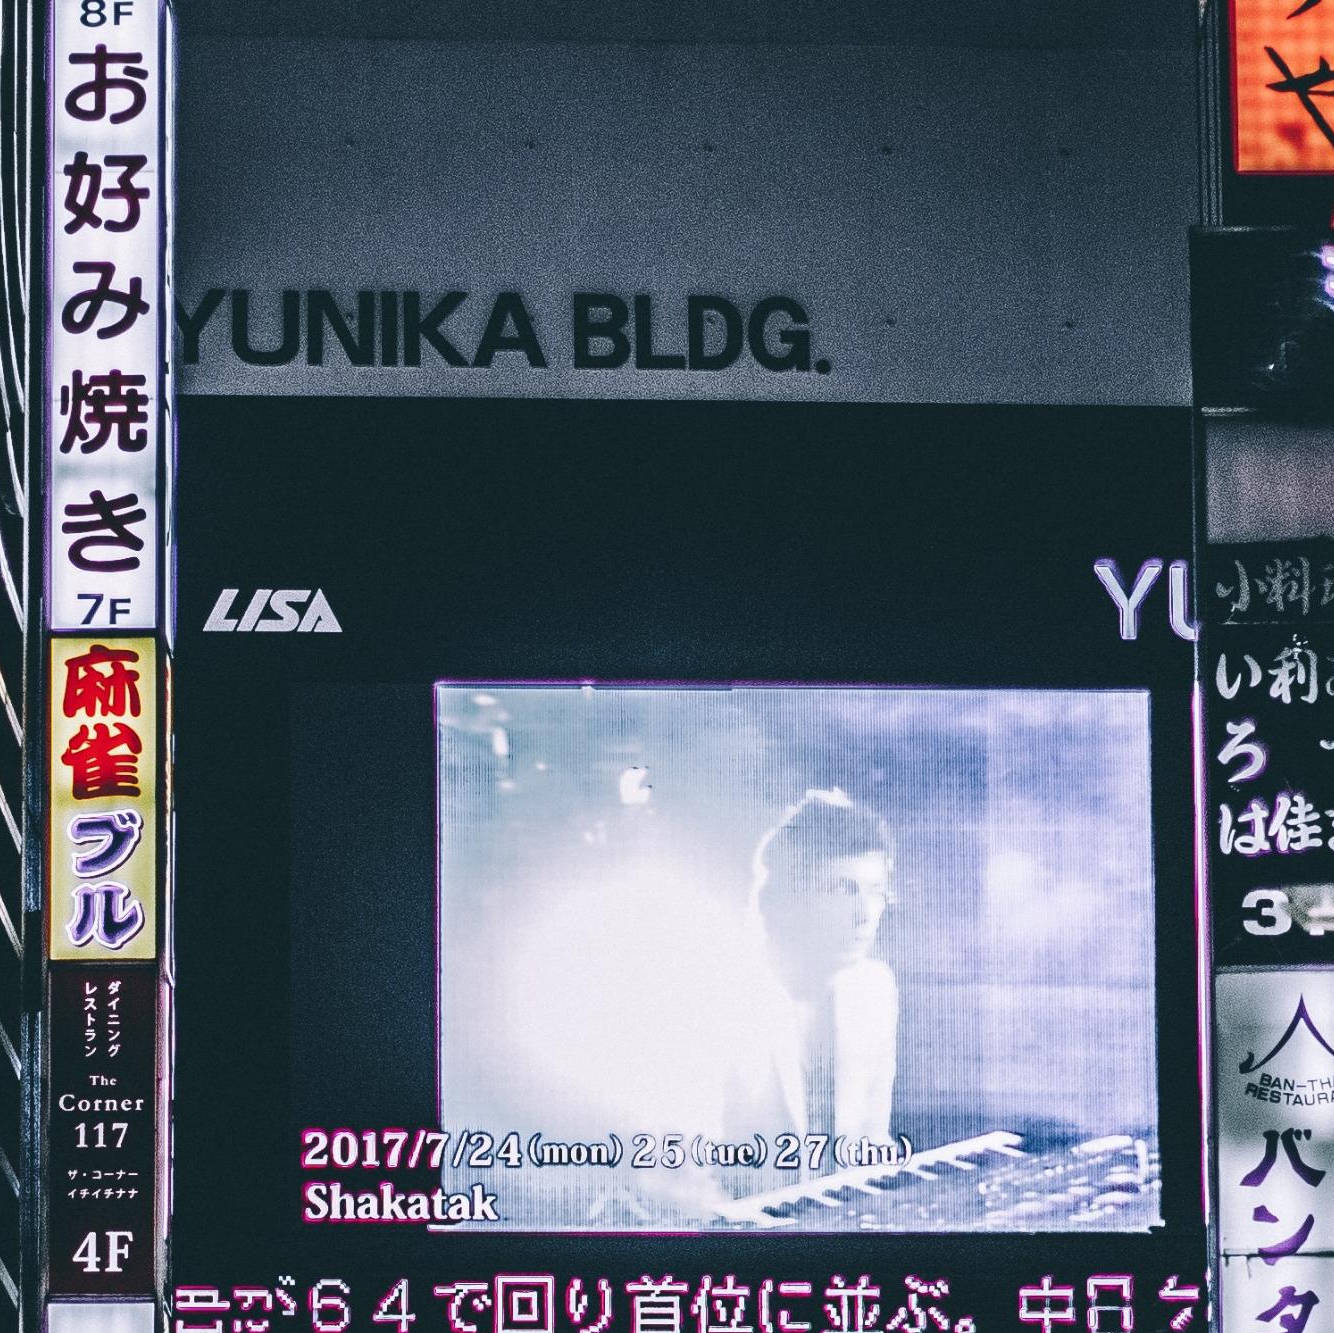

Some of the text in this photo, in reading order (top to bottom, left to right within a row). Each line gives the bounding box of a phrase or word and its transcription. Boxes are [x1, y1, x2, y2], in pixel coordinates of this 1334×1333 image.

[79, 1, 135, 28] 8F
[59, 43, 151, 574] お好み焼き
[173, 288, 832, 376] YUNIKA BLDG.
[76, 593, 133, 626] 7F
[201, 587, 343, 633] LISA
[84, 981, 98, 1058] レストラン
[107, 980, 121, 1058] ダイニング
[89, 1075, 117, 1086] The
[58, 1094, 144, 1113] Corner
[73, 1122, 129, 1149] 117
[67, 1188, 139, 1200] イチイチナナ
[304, 1183, 499, 1223] Shakatak
[72, 1230, 134, 1273] 4F
